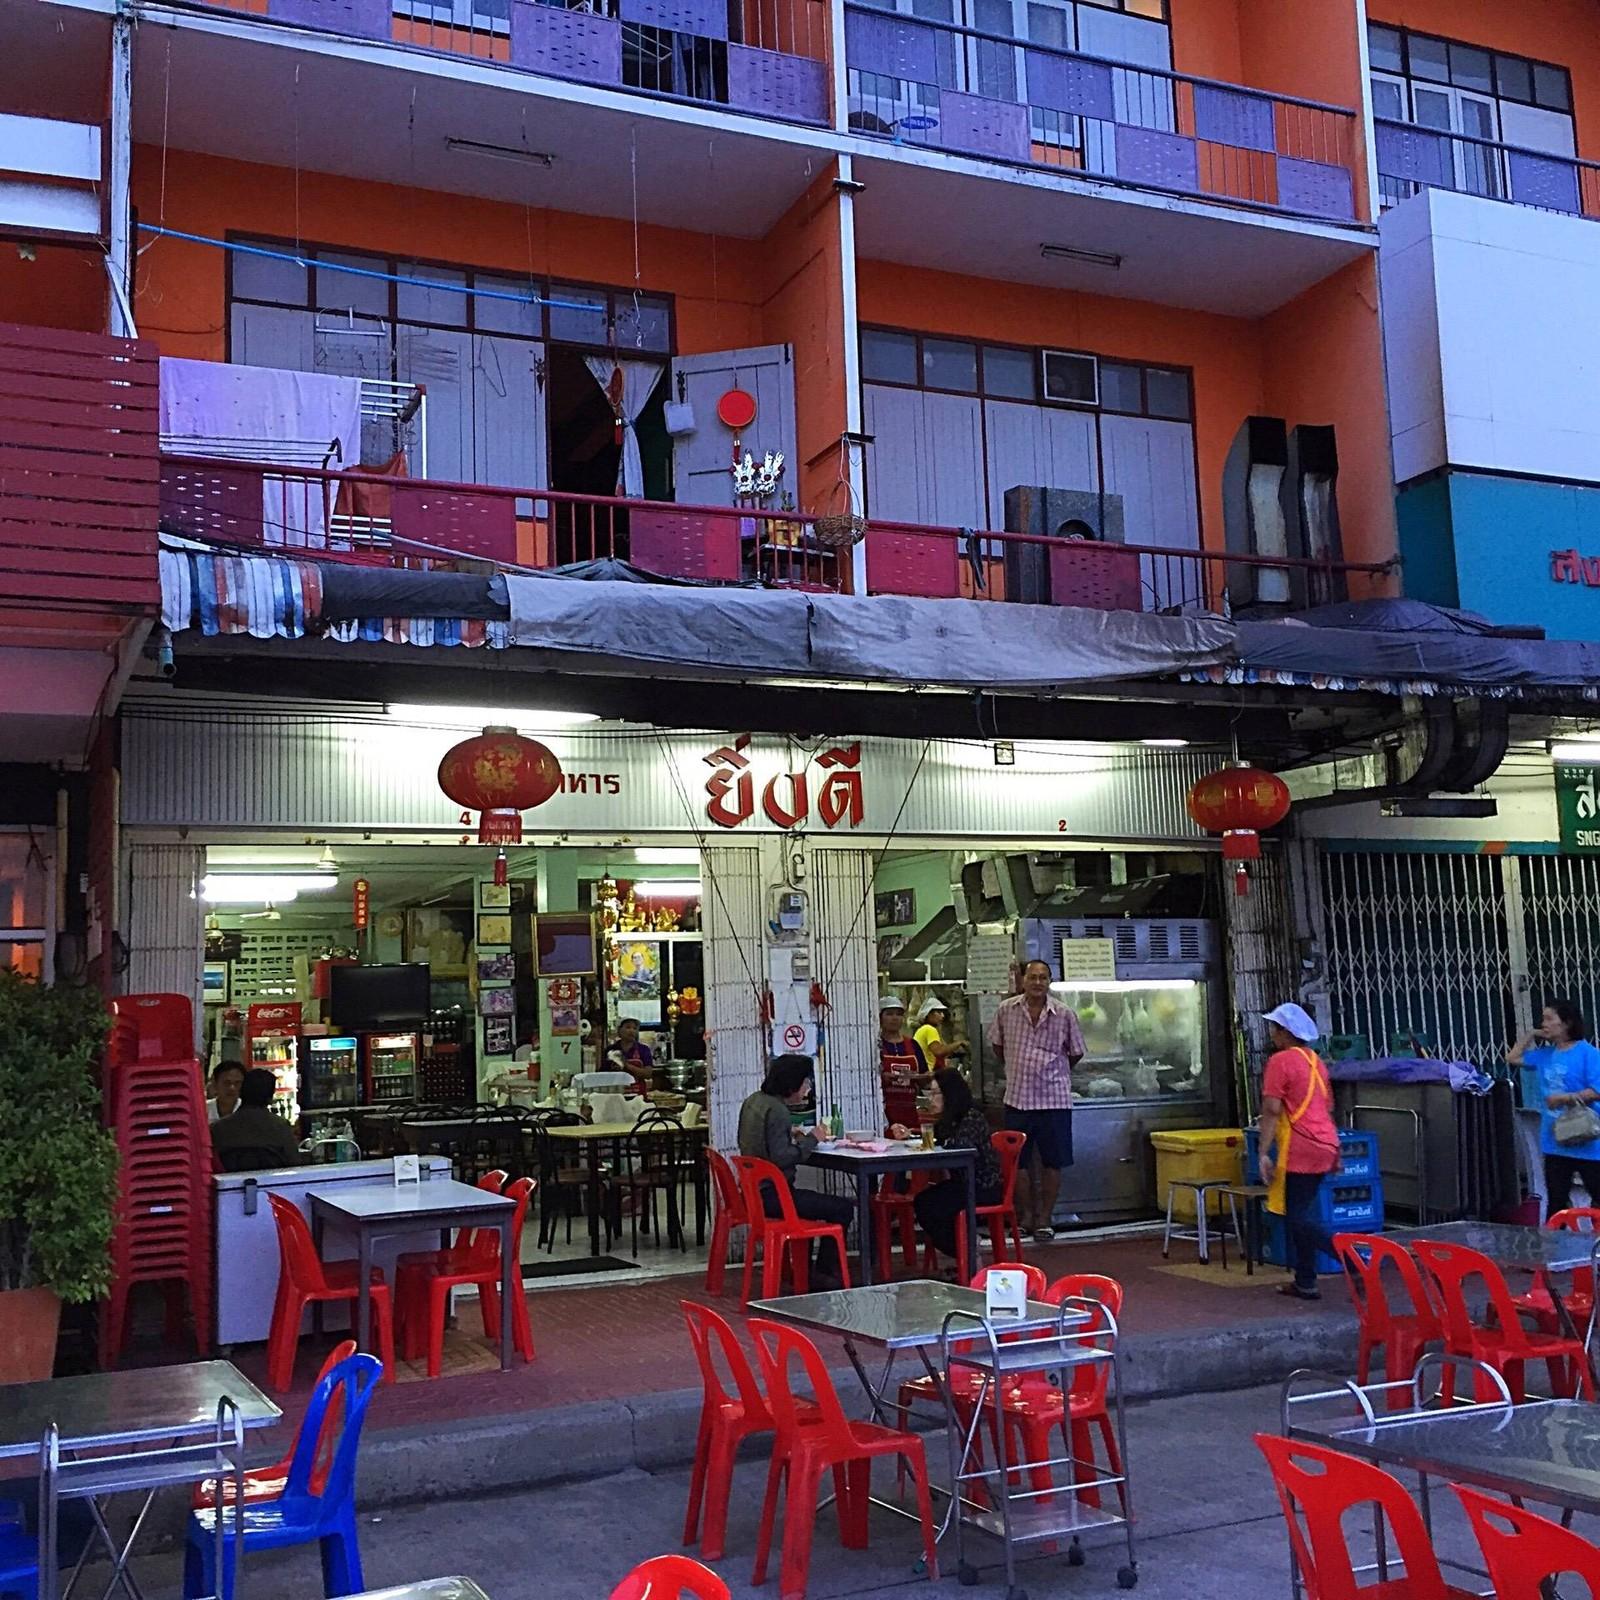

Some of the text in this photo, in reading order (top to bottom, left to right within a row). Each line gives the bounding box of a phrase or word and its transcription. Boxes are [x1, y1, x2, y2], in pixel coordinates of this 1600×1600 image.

[559, 773, 620, 794] าหาร
[1058, 819, 1068, 832] 2
[560, 1041, 571, 1055] 7
